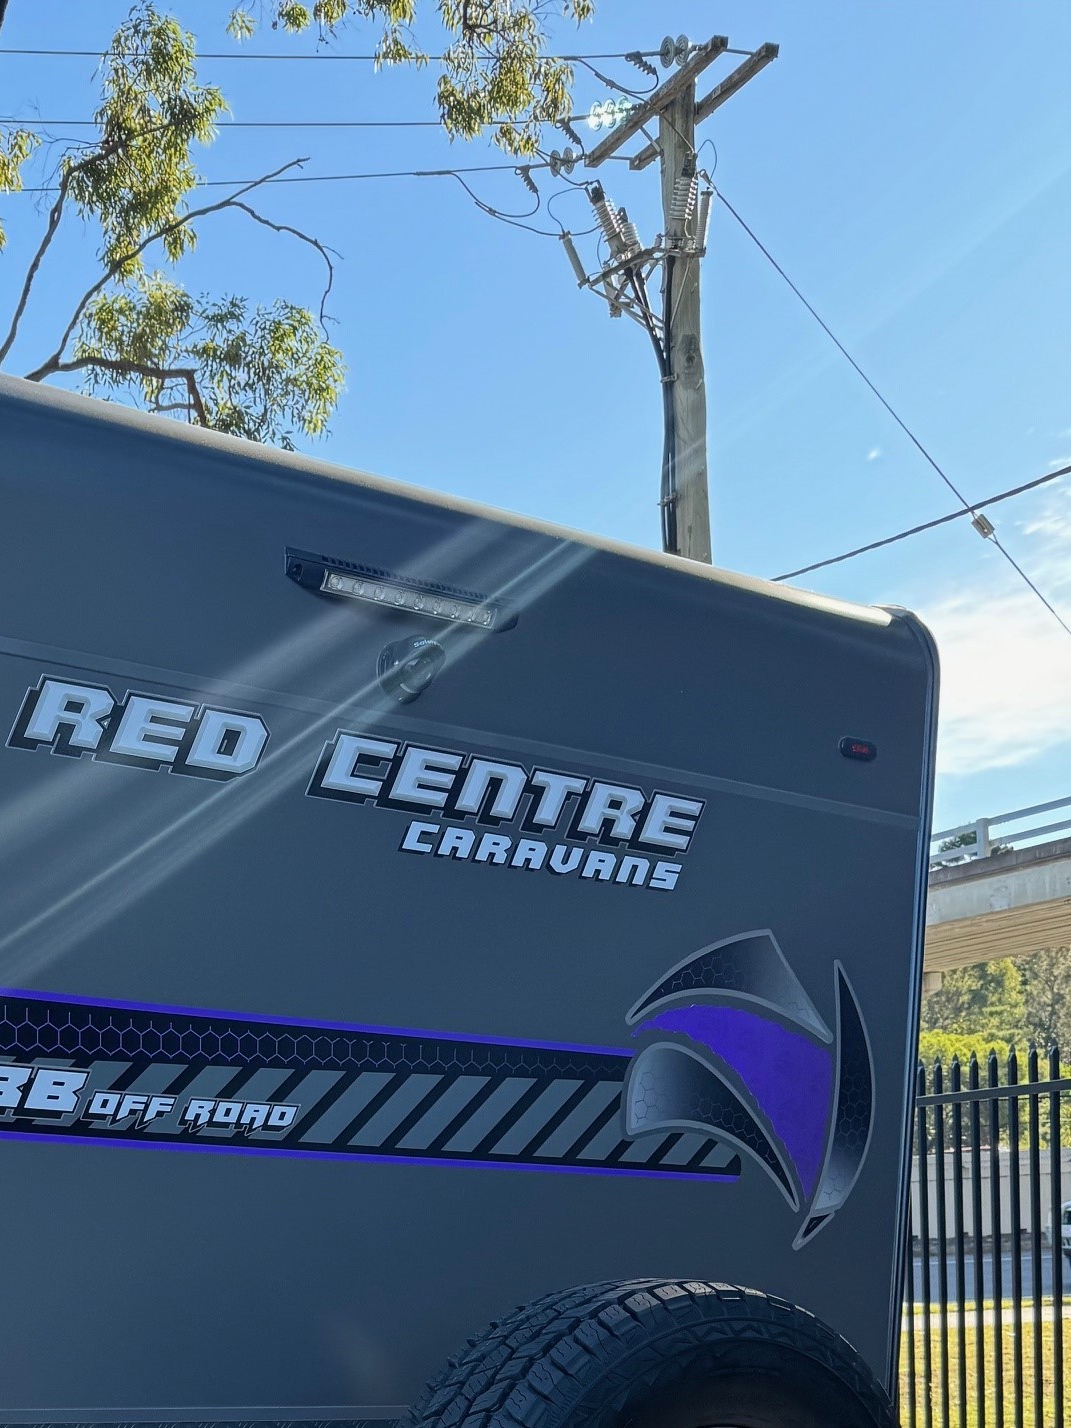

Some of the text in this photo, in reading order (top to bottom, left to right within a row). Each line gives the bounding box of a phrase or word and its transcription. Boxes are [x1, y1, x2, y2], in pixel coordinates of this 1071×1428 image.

[21, 675, 704, 854] RED CENTRE
[400, 820, 683, 891] CARAVANS
[87, 1090, 176, 1123] OFF
[183, 1096, 299, 1128] ROAD
